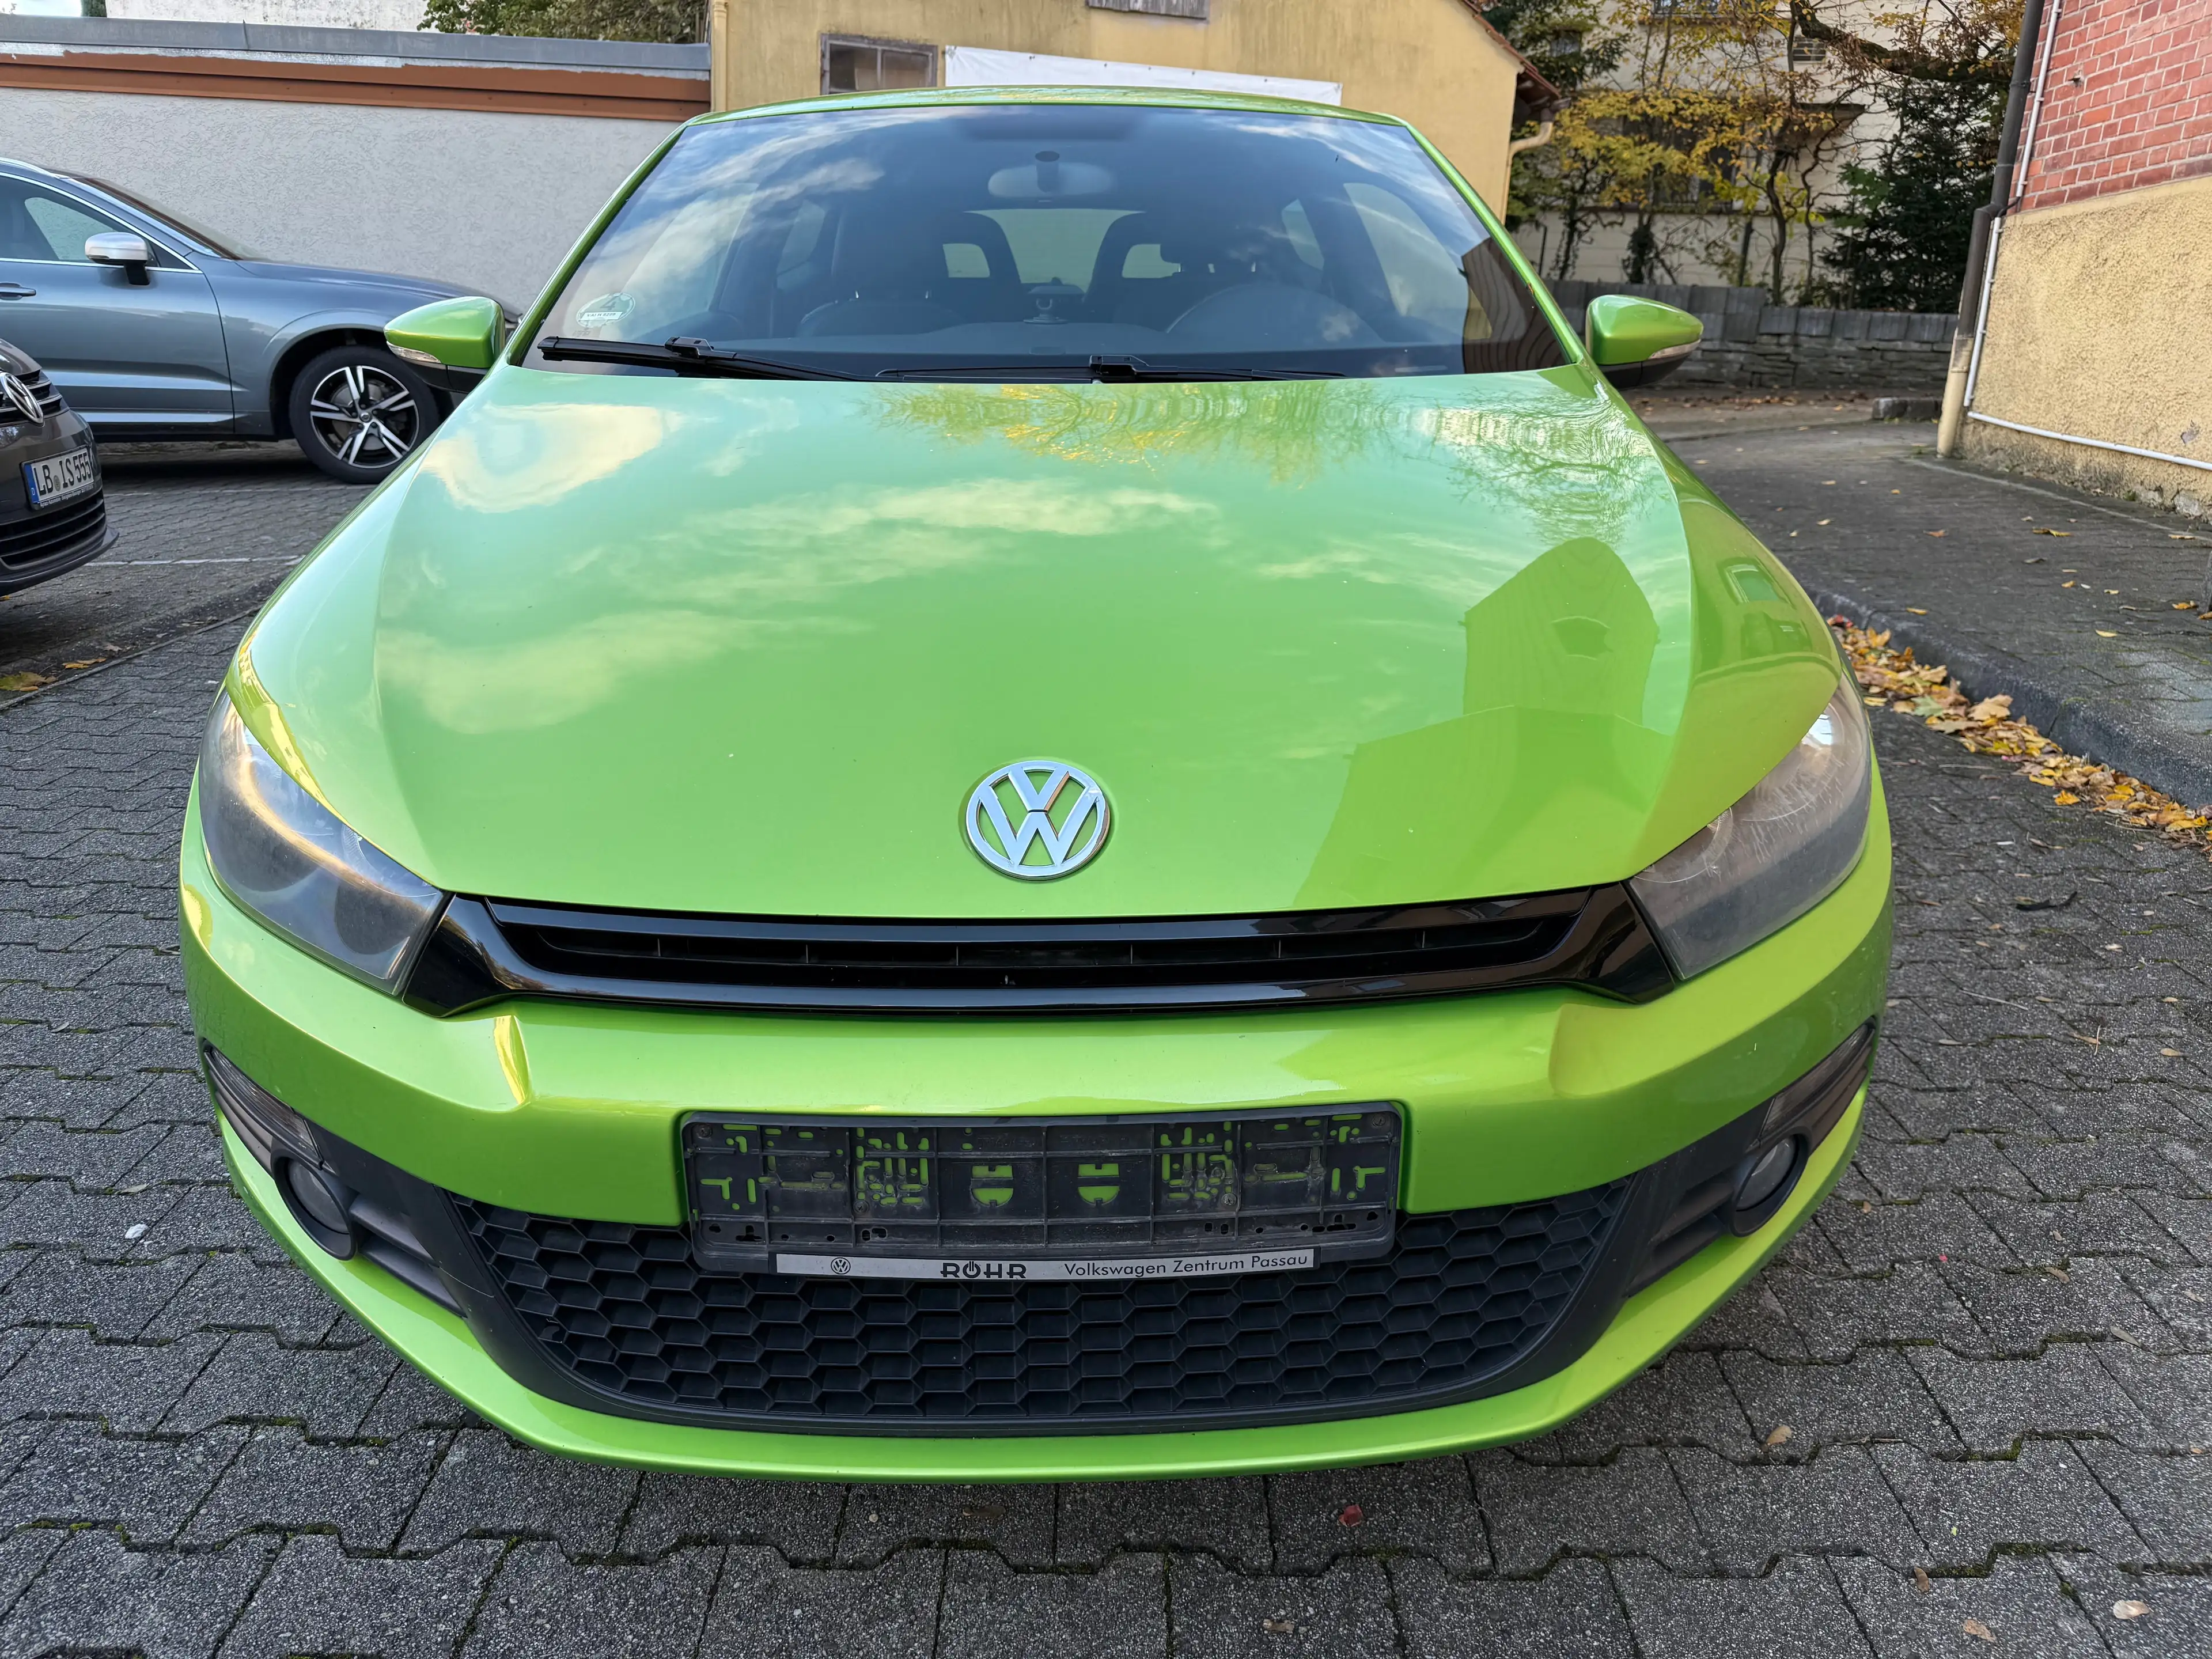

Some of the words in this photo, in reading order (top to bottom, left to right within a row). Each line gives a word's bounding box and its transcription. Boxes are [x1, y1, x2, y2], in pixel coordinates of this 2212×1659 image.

[31, 487, 36, 495] D
[33, 464, 54, 495] LB
[967, 760, 1109, 878] VW
[940, 1261, 1027, 1279] RÖHR
[1065, 1263, 1166, 1278] Volkswagen
[1173, 1260, 1244, 1273] Zentrum
[1251, 1255, 1308, 1268] Passau
